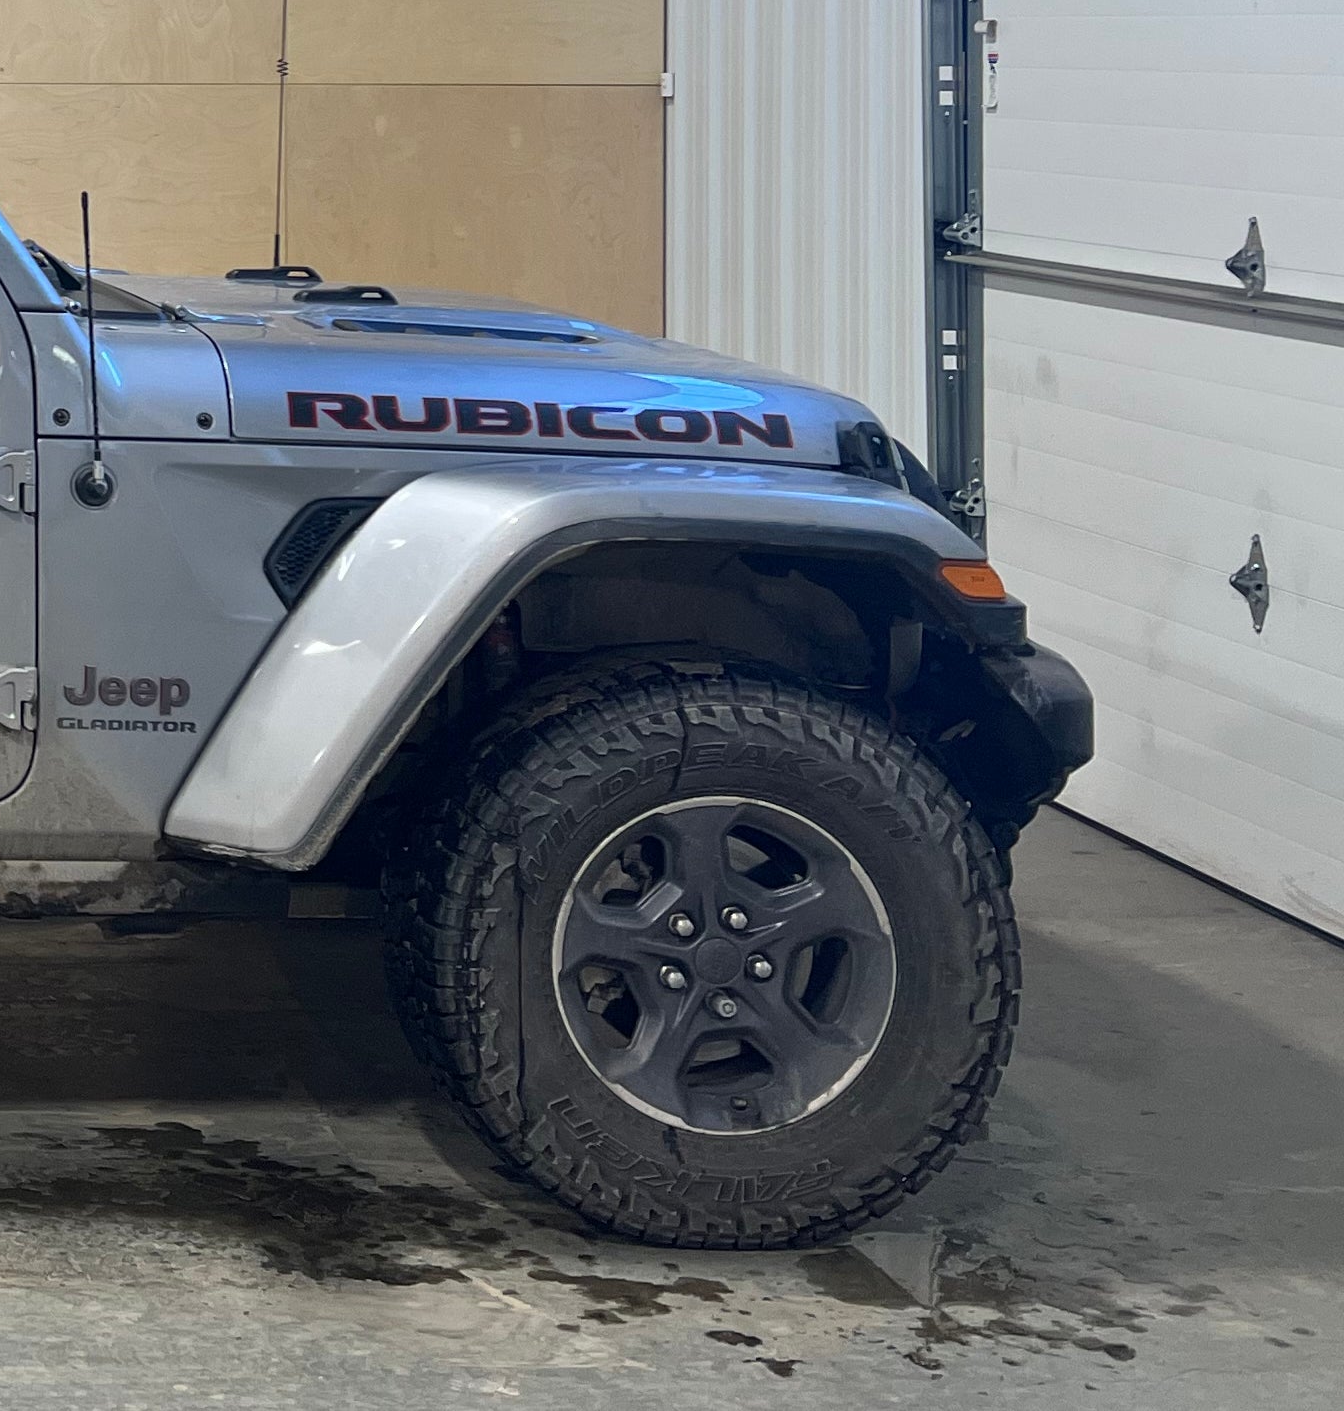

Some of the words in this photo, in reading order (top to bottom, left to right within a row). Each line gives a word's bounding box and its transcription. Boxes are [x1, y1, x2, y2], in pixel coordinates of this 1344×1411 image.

[285, 390, 794, 449] RUBICON
[63, 664, 191, 716] Jeep
[56, 716, 198, 734] GLADIATOR
[517, 740, 827, 906] WILDPEAK
